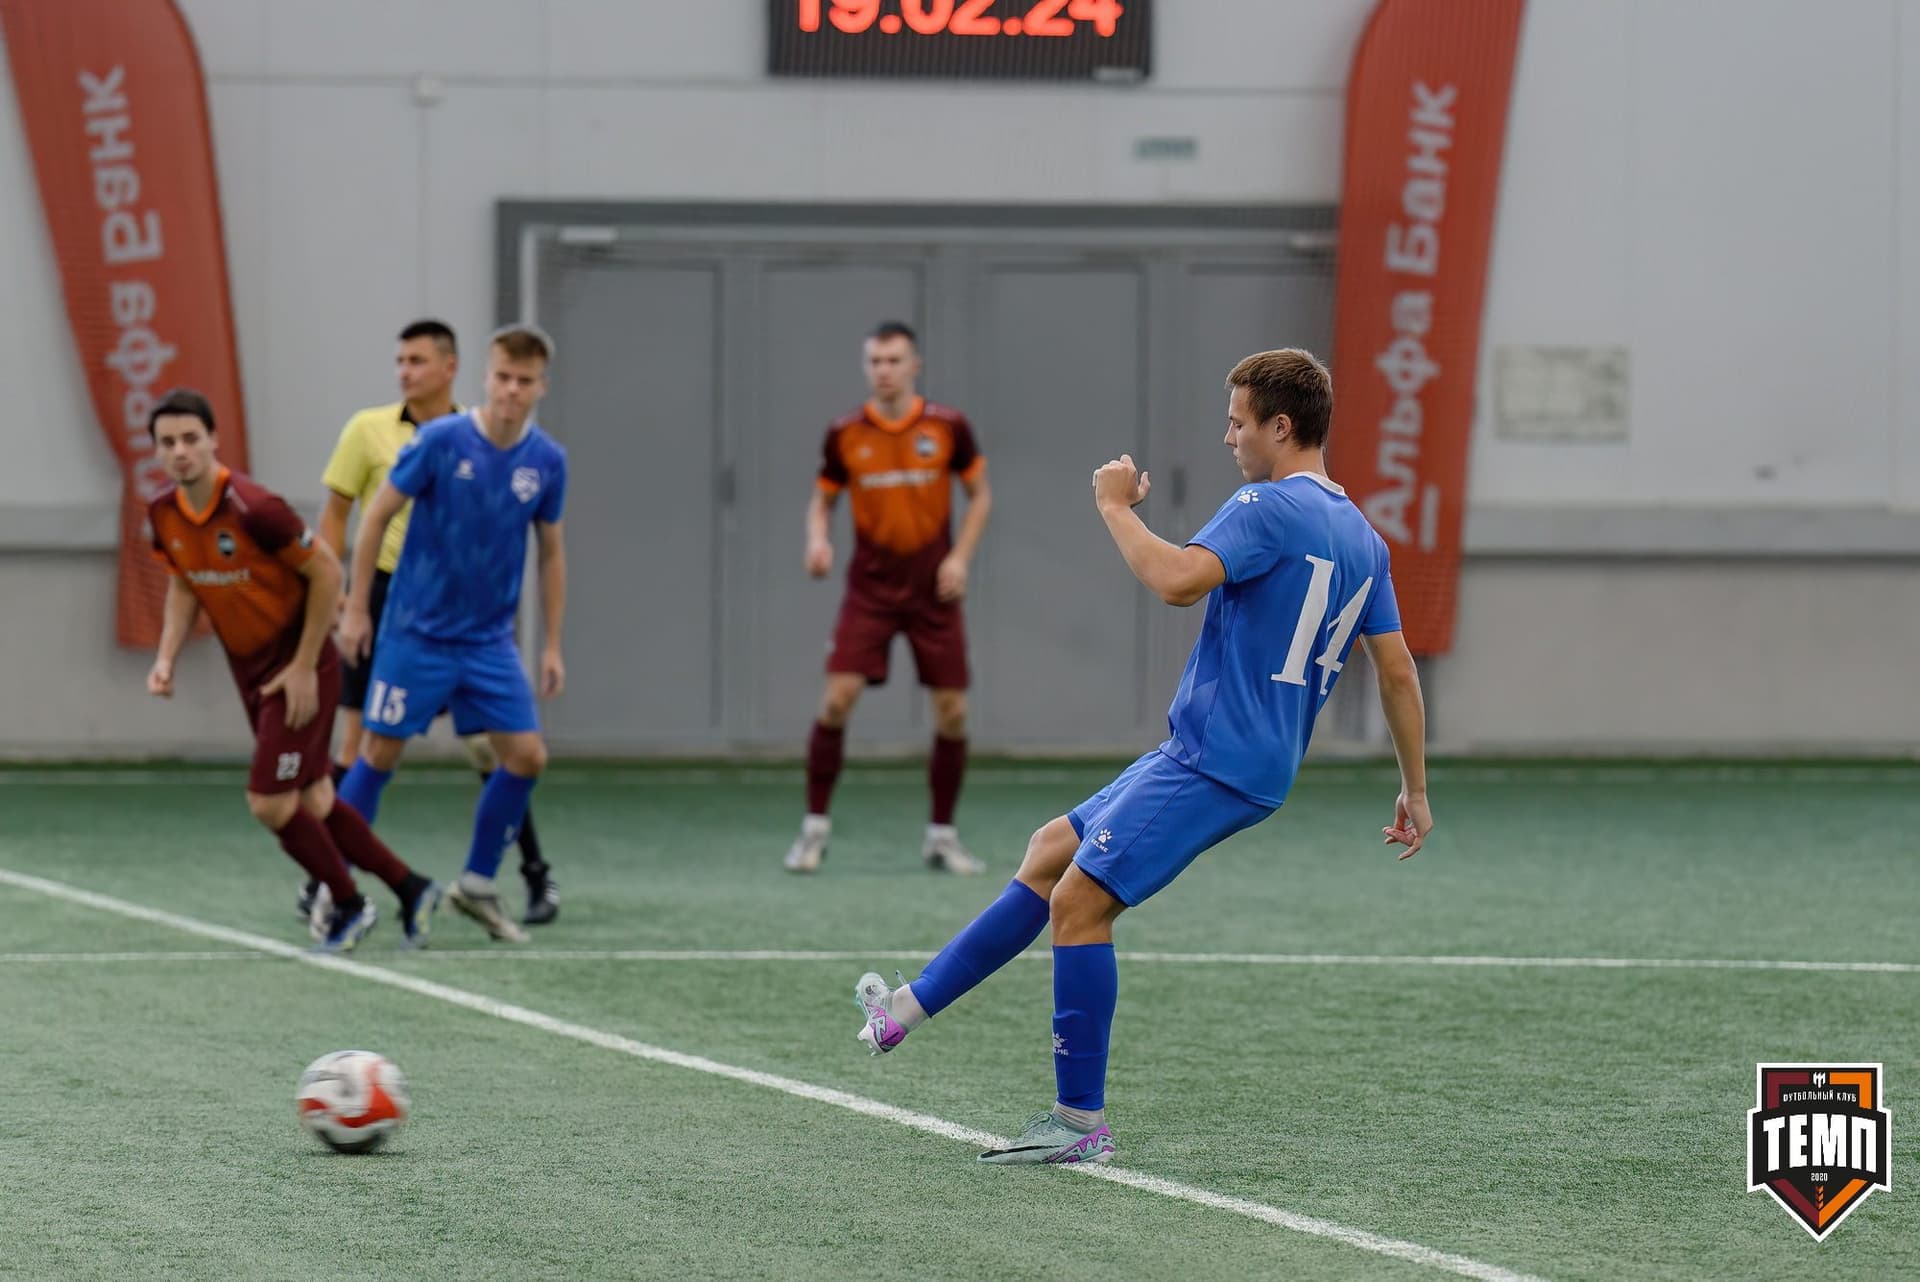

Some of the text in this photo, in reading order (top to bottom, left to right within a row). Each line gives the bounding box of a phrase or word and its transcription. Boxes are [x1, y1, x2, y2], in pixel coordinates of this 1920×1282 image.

[1363, 80, 1458, 545] Альфа Банк
[1271, 554, 1373, 695] 14
[367, 679, 407, 726] 15
